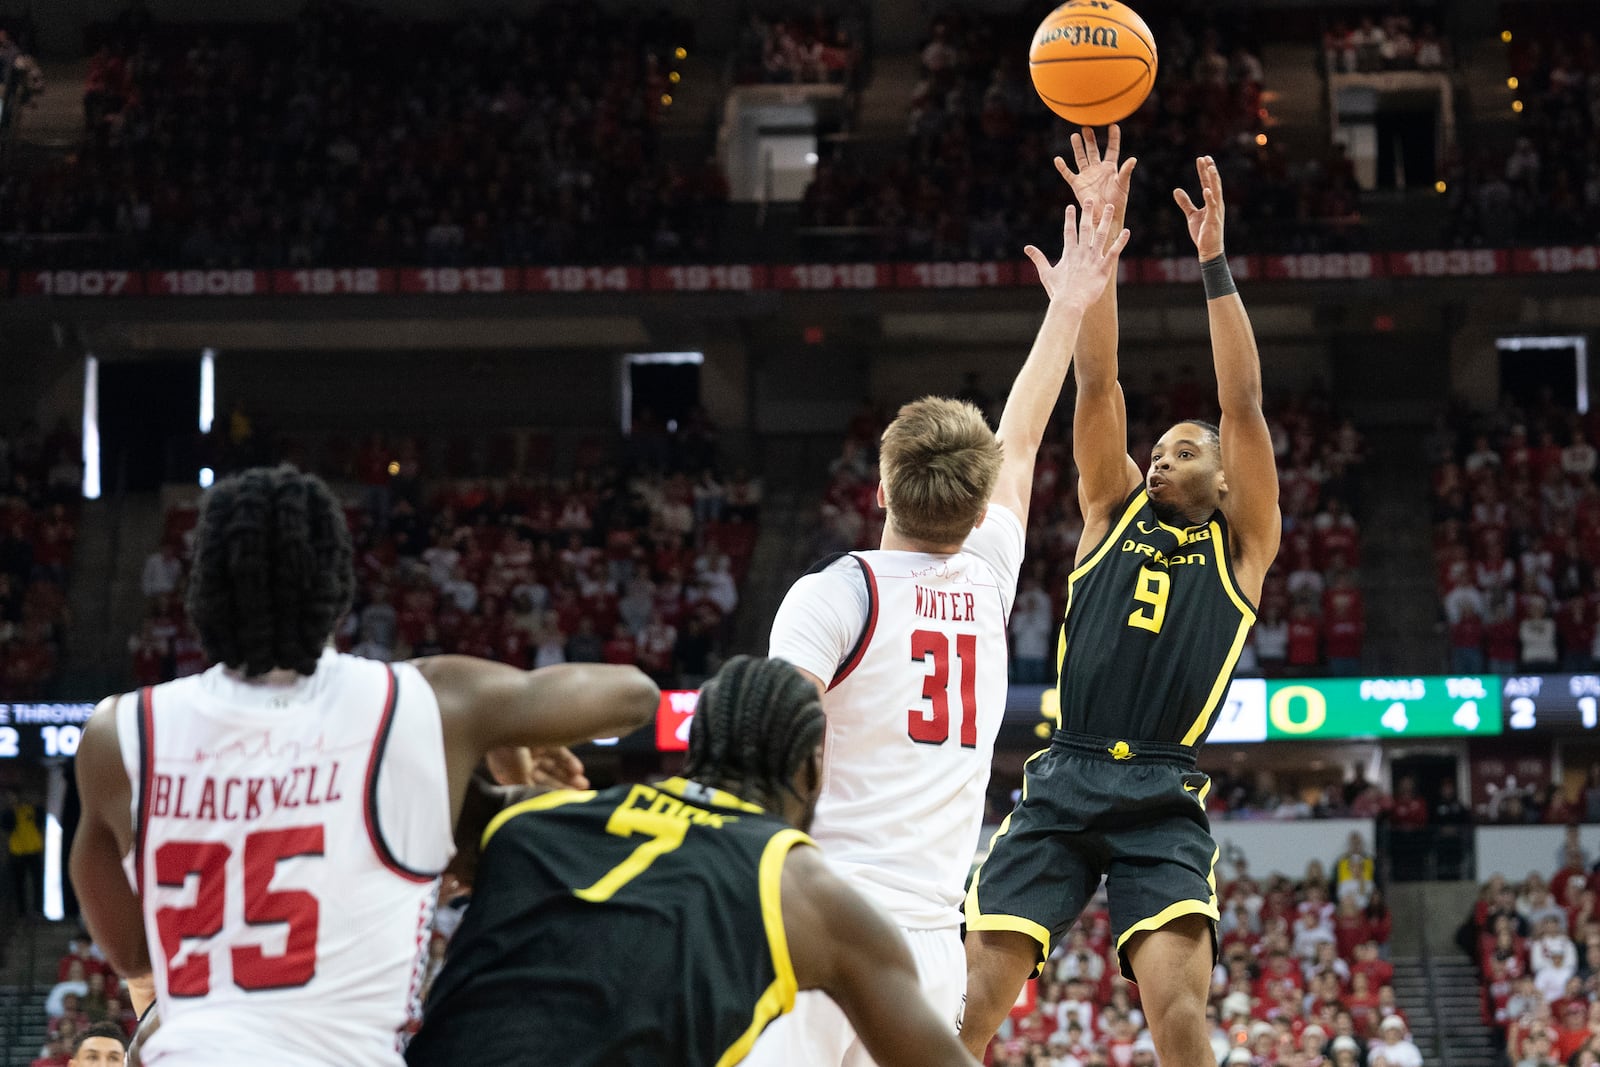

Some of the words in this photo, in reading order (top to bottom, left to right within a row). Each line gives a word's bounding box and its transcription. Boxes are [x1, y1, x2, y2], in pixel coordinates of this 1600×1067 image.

[1041, 25, 1118, 48] Wilson
[36, 270, 129, 295] 1907
[162, 270, 256, 294] 1908
[419, 267, 505, 292] 1913
[544, 266, 630, 291] 1914
[1159, 256, 1249, 282] 194
[1405, 249, 1496, 275] 1935
[1530, 246, 1600, 272] 194
[915, 585, 975, 621] WINTER
[1128, 564, 1171, 634] 9
[908, 629, 977, 748] 31
[1360, 678, 1425, 700] FOULS
[1445, 677, 1487, 699] TOL
[1503, 677, 1542, 697] AST
[1381, 702, 1408, 732] 4
[1453, 701, 1480, 731] 4
[1510, 697, 1536, 729] 2
[1577, 697, 1598, 729] 1
[41, 725, 81, 757] 10
[153, 763, 341, 820] BLACKWELL
[573, 803, 691, 903] 7
[156, 824, 325, 998] 25
